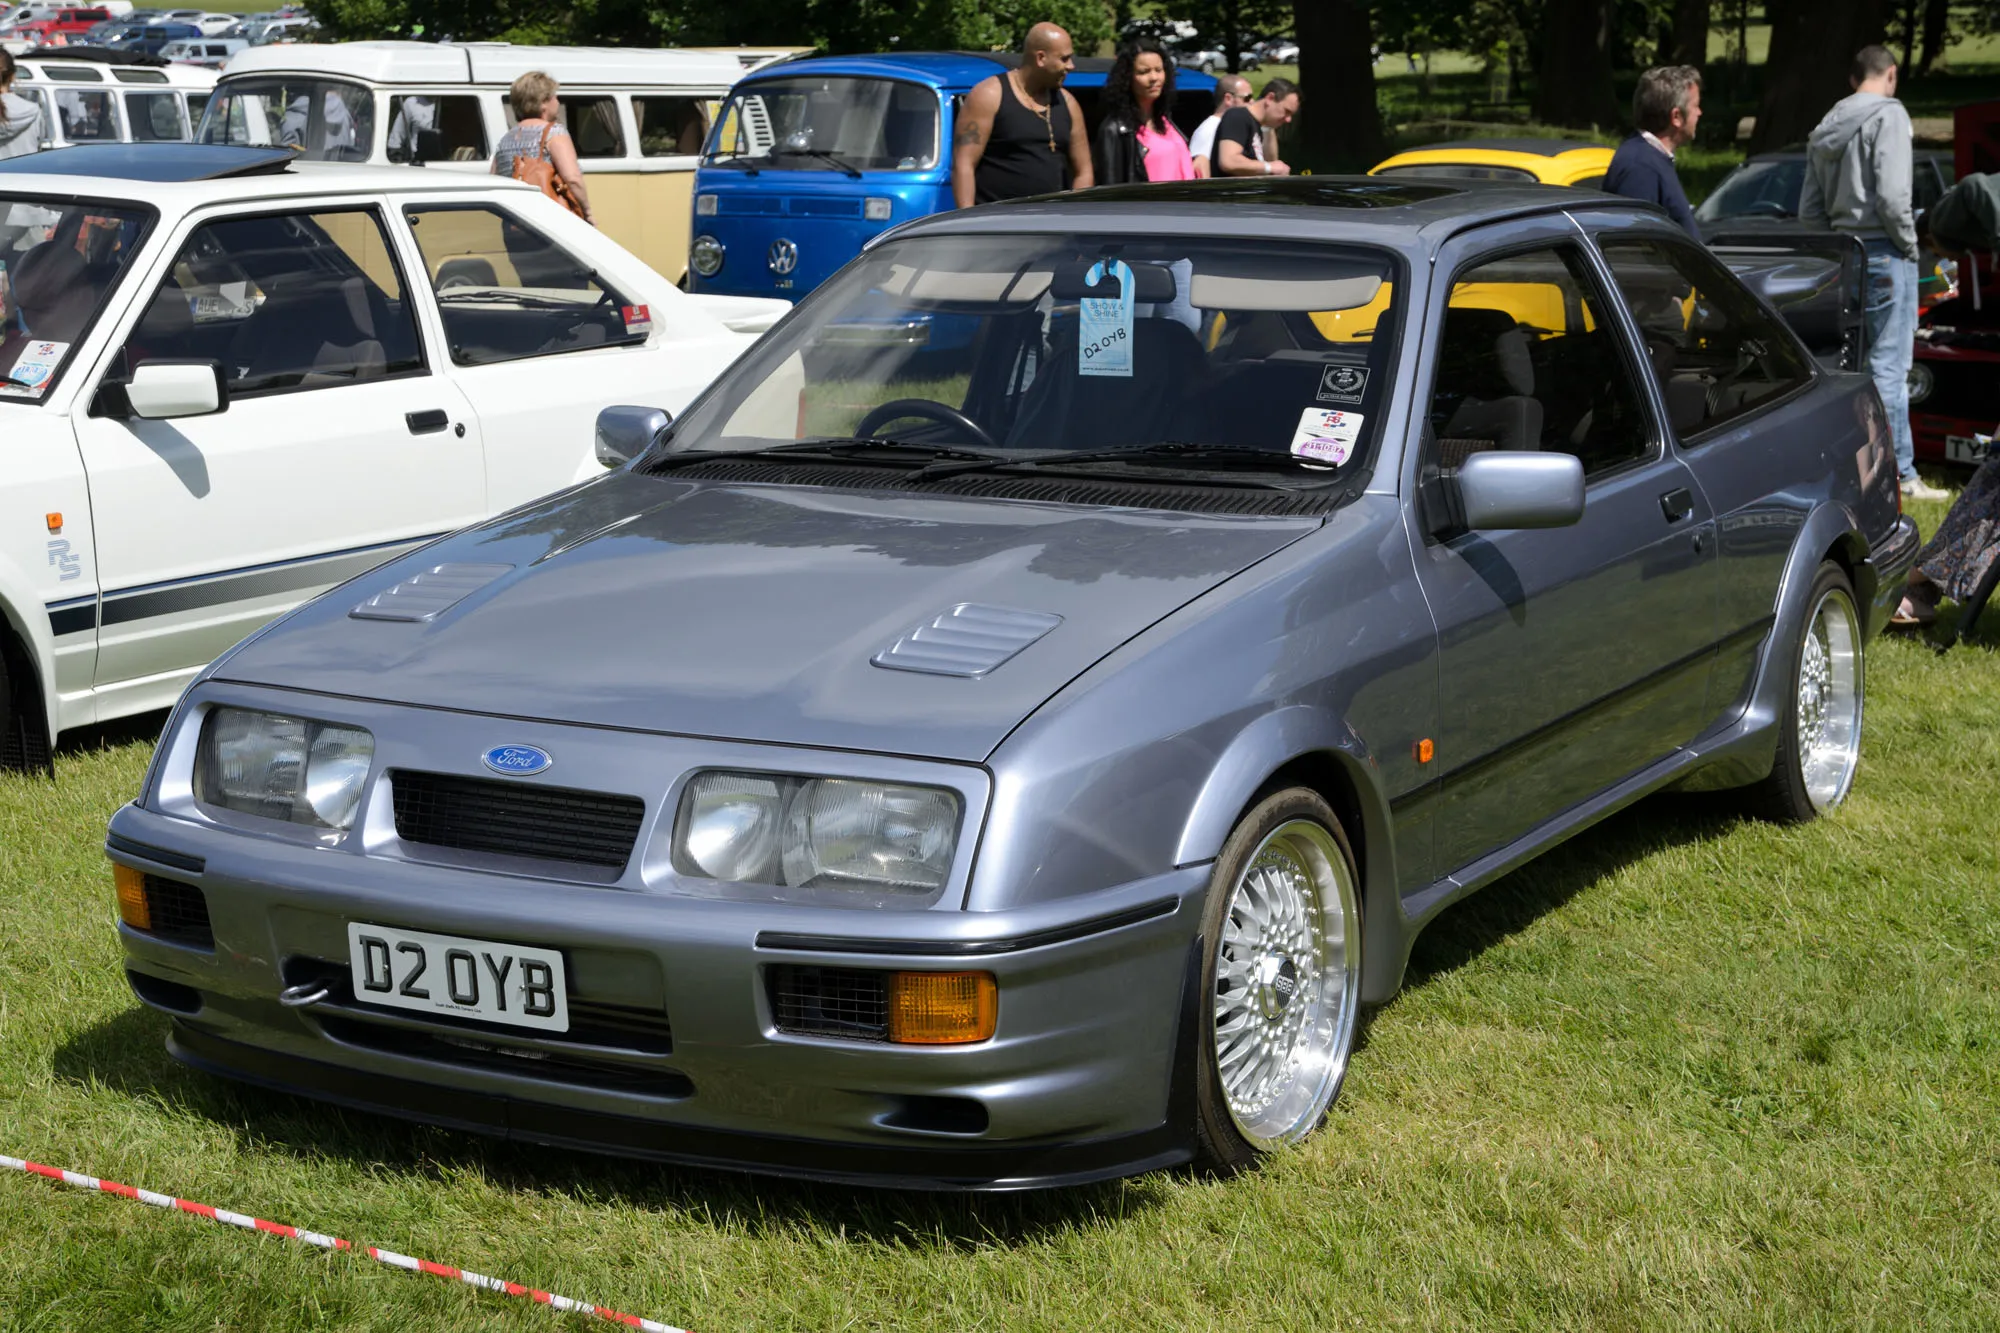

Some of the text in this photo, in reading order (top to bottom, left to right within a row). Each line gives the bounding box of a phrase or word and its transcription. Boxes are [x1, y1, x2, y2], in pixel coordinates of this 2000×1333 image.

[1090, 302, 1116, 310] SHOW
[1094, 310, 1119, 318] SHINE
[497, 748, 536, 767] Ford
[358, 934, 431, 1000] D2
